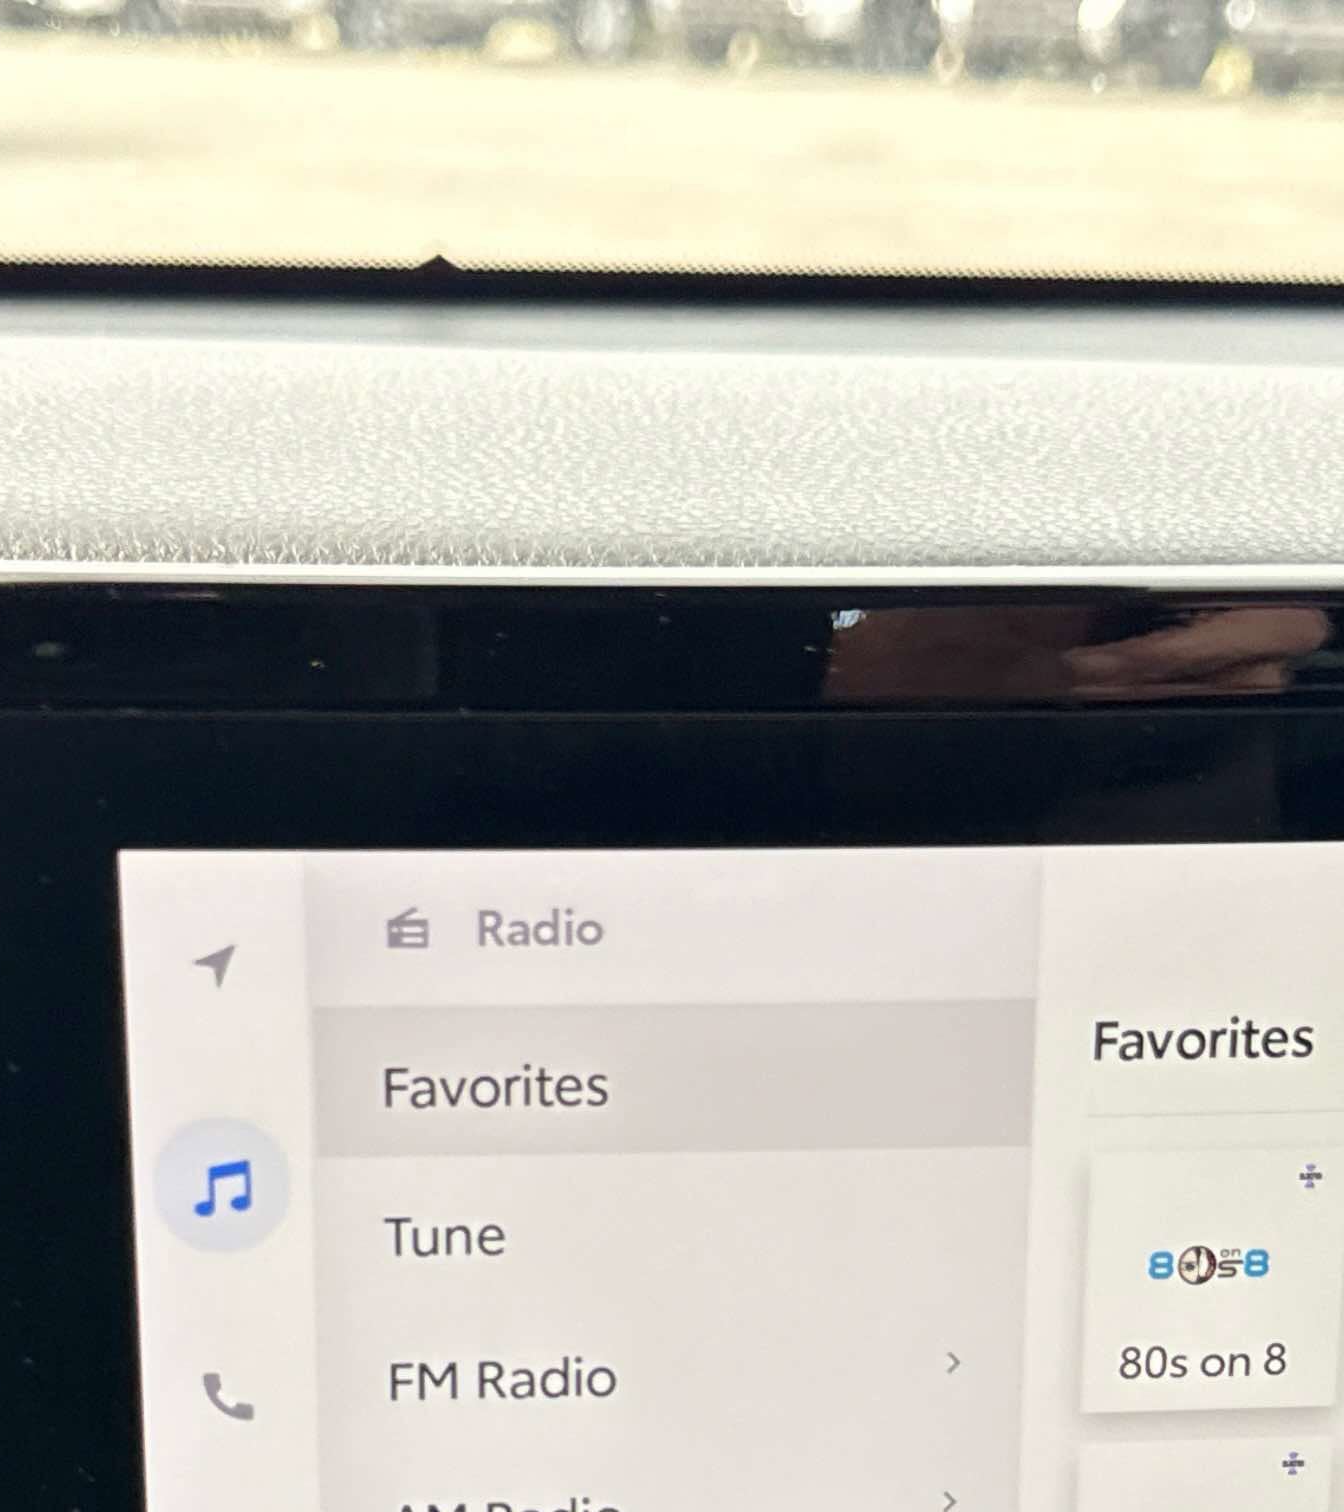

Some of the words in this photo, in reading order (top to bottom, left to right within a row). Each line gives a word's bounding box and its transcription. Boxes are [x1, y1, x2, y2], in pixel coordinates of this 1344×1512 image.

[478, 908, 604, 946] Radio
[1095, 1016, 1313, 1061] Favorites
[385, 1064, 608, 1108] Favorites
[384, 1218, 504, 1257] Tune
[391, 1362, 457, 1400] FM
[479, 1357, 616, 1399] Radio
[1120, 1346, 1187, 1379] 80s
[1201, 1354, 1250, 1376] on
[1264, 1343, 1286, 1375] 8
